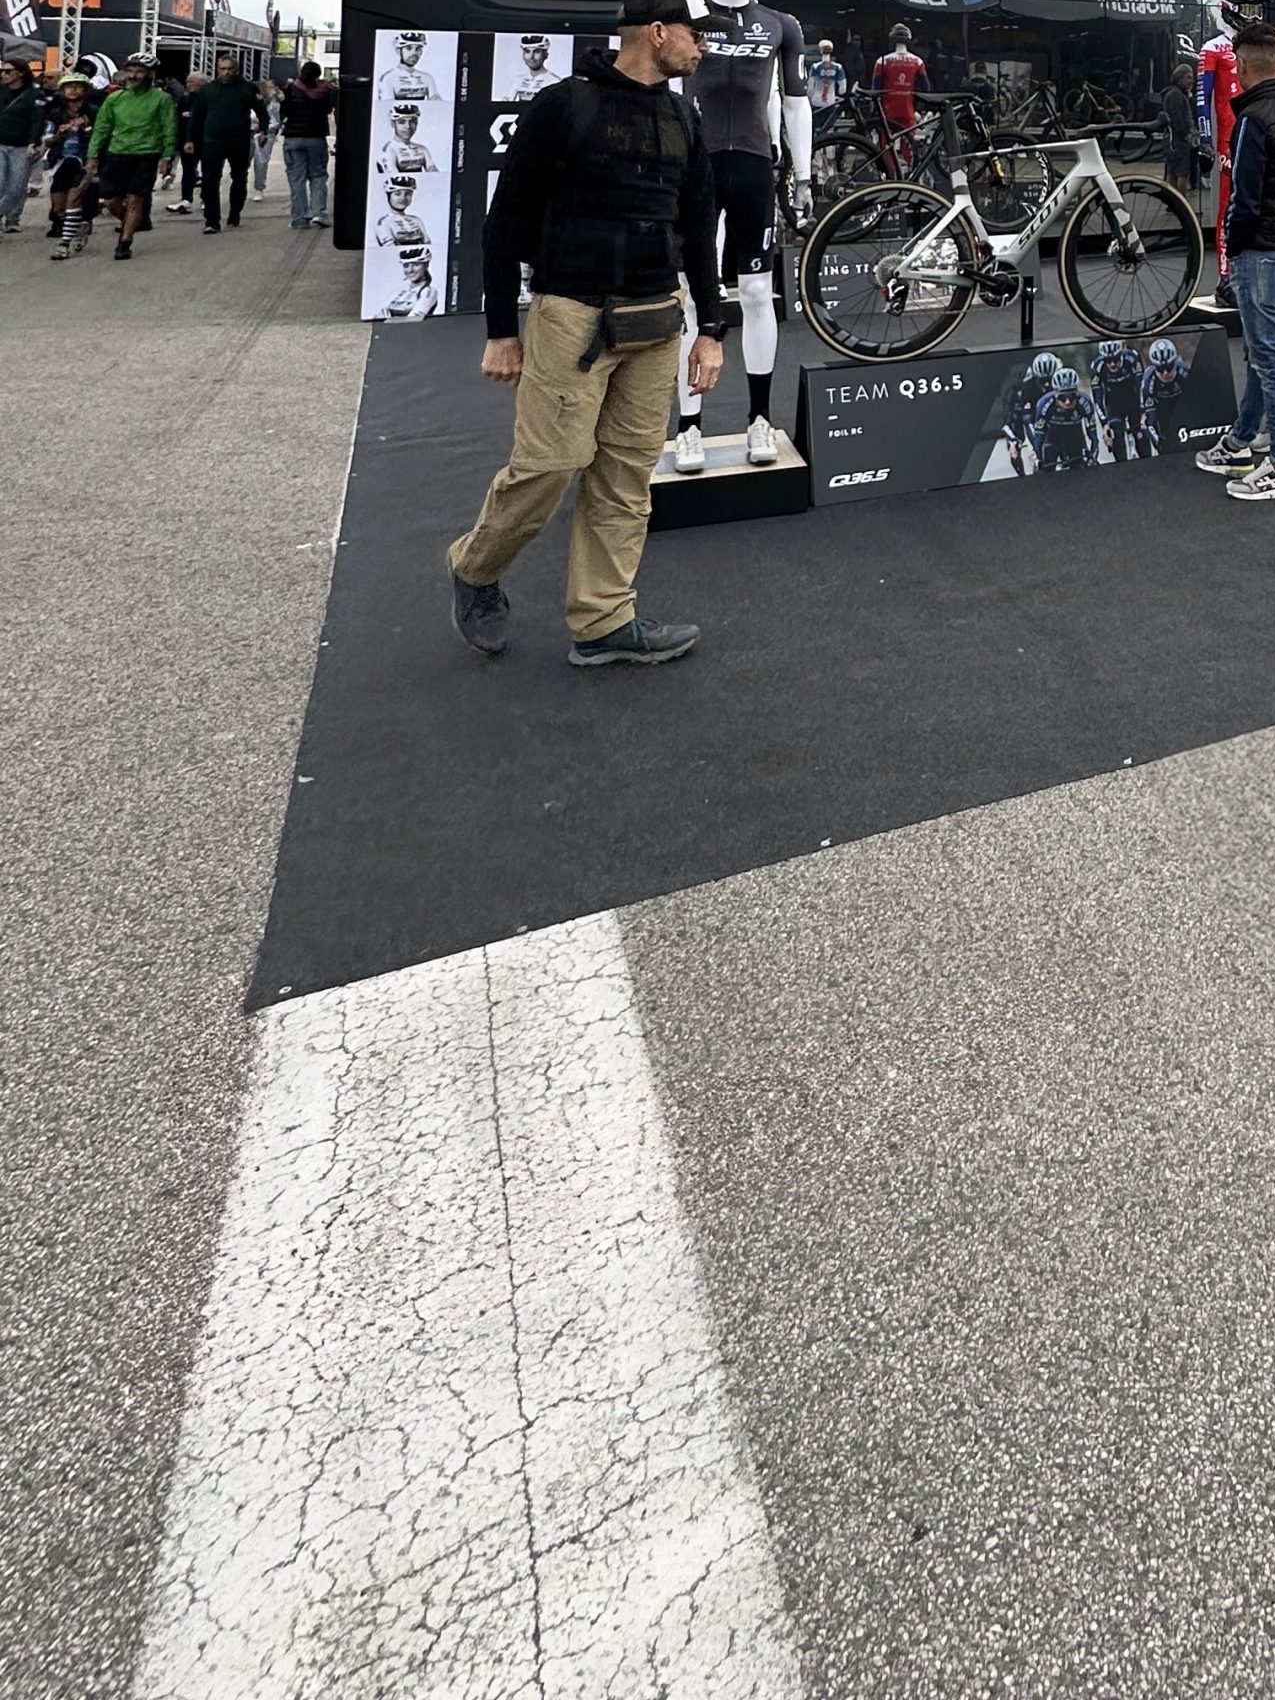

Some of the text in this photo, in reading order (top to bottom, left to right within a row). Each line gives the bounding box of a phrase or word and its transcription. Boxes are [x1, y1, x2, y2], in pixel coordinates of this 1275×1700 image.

[1017, 183, 1069, 247] SCOTT
[825, 374, 964, 405] TEAM Q36.5
[1188, 424, 1233, 440] SCOTT
[829, 468, 891, 489] Q36.5
